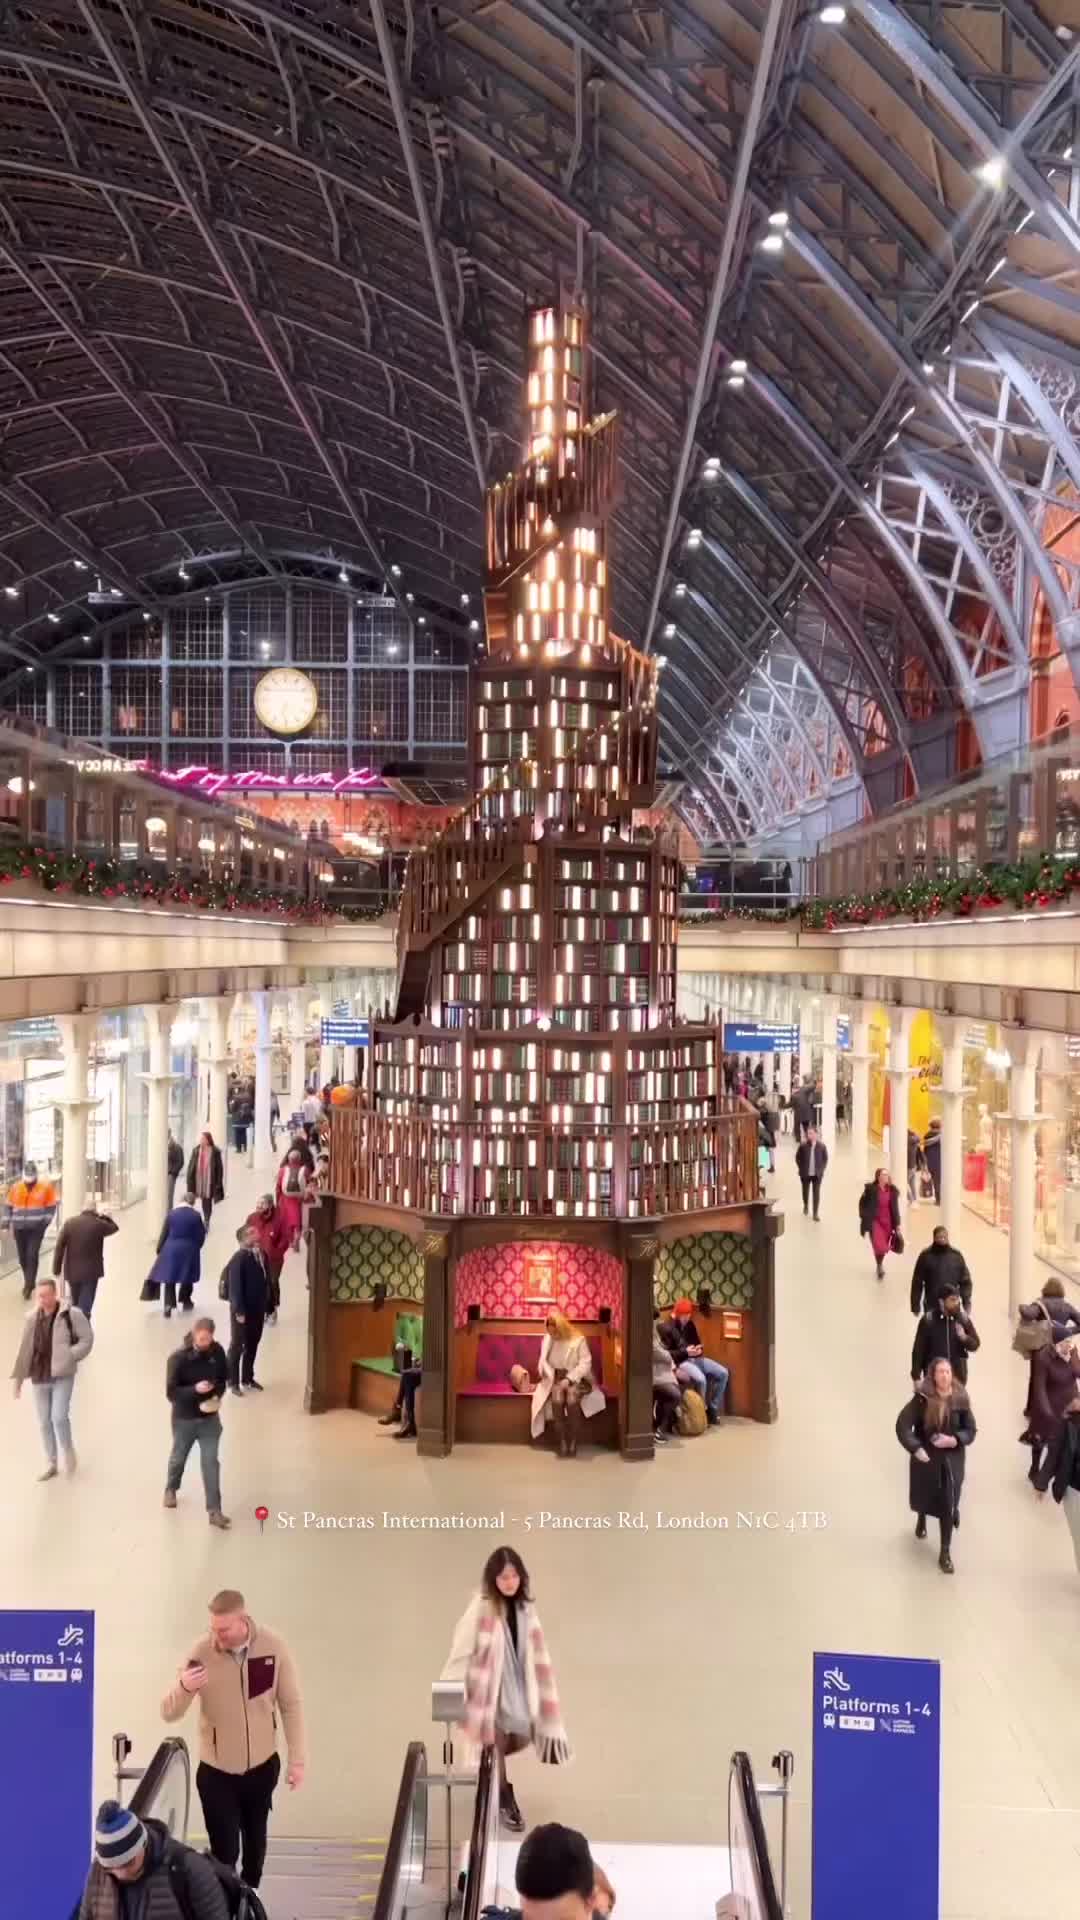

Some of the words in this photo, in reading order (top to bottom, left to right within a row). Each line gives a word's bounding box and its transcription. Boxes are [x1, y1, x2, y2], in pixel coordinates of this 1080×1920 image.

[58, 1651, 83, 1665] 1-4
[823, 1695, 900, 1714] Platforms
[905, 1701, 932, 1717] 1-4
